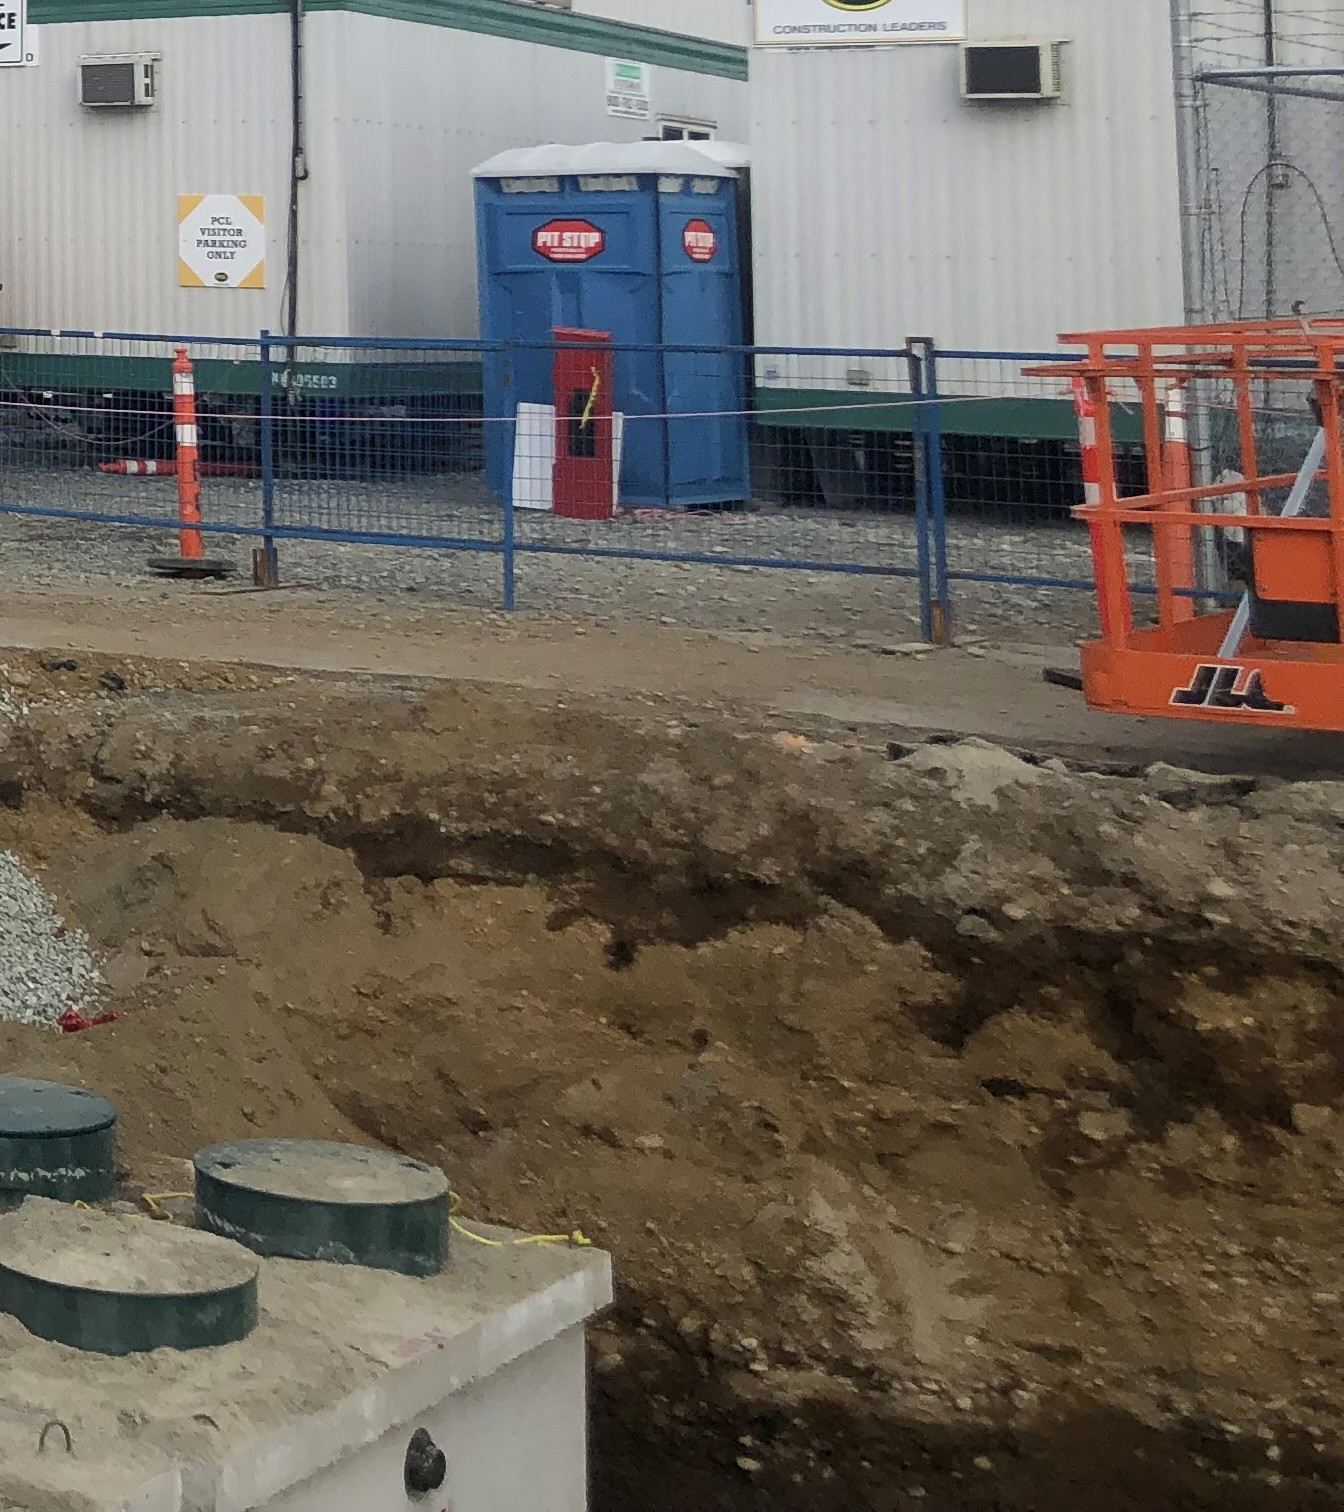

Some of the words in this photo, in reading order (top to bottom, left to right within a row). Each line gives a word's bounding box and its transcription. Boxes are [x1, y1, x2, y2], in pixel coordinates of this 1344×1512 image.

[773, 23, 877, 35] CONSTRUCTION
[883, 21, 947, 32] LEADERS
[211, 217, 232, 226] PCL
[199, 228, 243, 237] VISITOR
[196, 239, 247, 248] PARKING
[537, 232, 560, 247] PIT
[562, 232, 602, 248] STOP
[206, 251, 236, 259] ONLY
